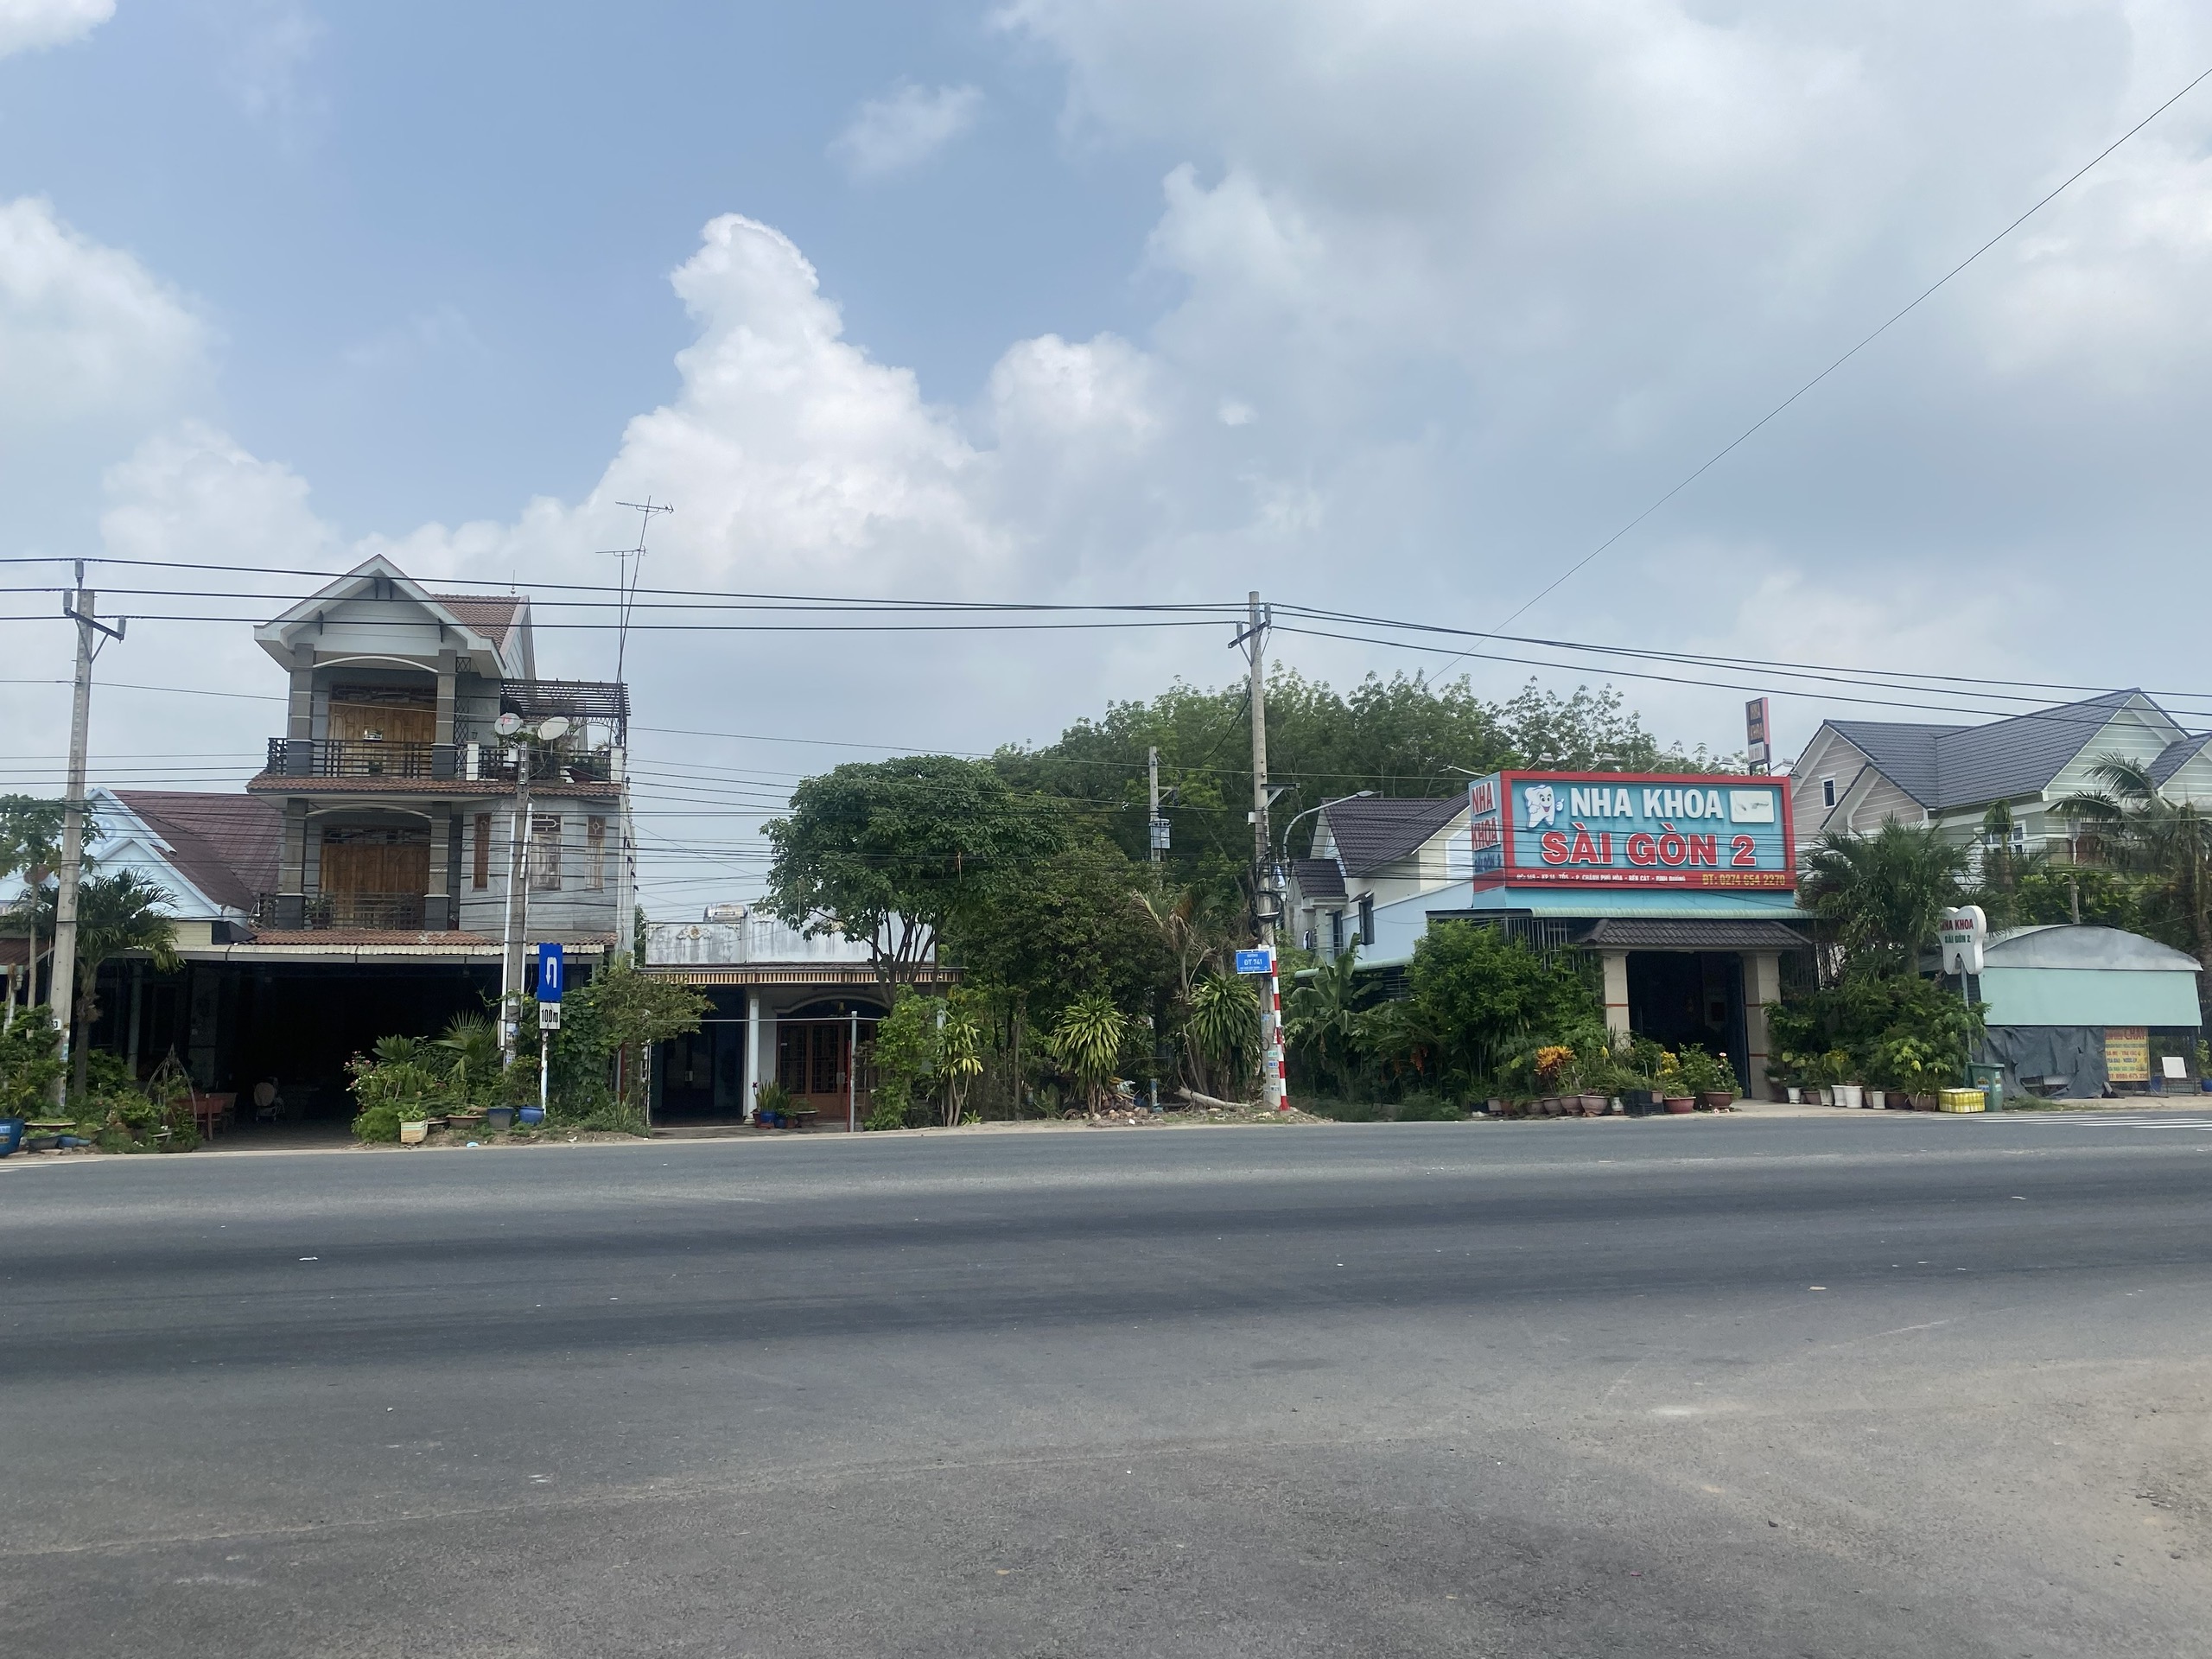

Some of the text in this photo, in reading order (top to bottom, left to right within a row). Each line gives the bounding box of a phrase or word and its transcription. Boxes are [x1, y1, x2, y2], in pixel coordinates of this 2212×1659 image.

[1472, 781, 1494, 814] NHA
[1570, 787, 1724, 819] NHA KHOA
[1471, 817, 1498, 850] KHOA
[1541, 822, 1757, 867] SÀI GÒN 2
[1702, 874, 1717, 886] ĐT:
[1719, 874, 1741, 886] 0274
[1764, 874, 1785, 886] 2270
[1955, 918, 1974, 930] KHOA
[541, 1009, 558, 1022] 100m
